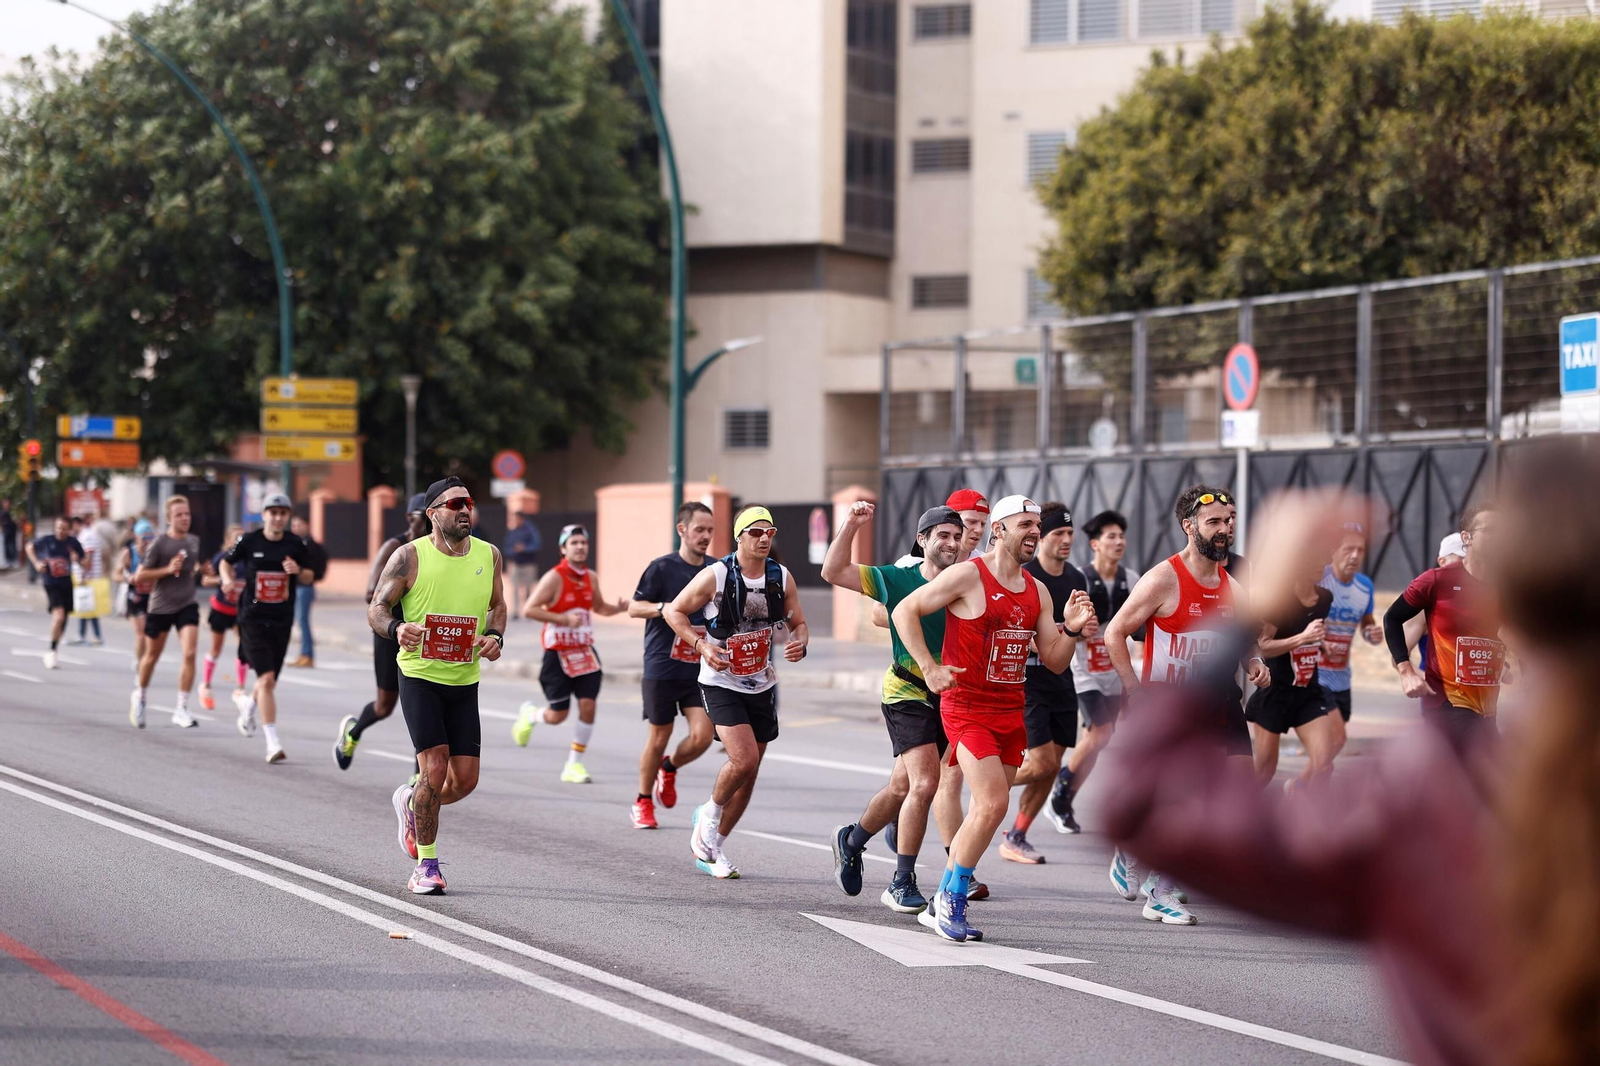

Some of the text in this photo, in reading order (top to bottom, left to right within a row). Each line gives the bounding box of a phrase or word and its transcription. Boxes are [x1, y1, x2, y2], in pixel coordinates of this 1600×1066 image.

[1562, 341, 1597, 370] TAXI
[440, 616, 471, 624] GENERALI
[436, 626, 462, 636] 6248
[741, 641, 758, 651] 419
[1006, 644, 1023, 654] 537
[1469, 650, 1492, 659] 6692
